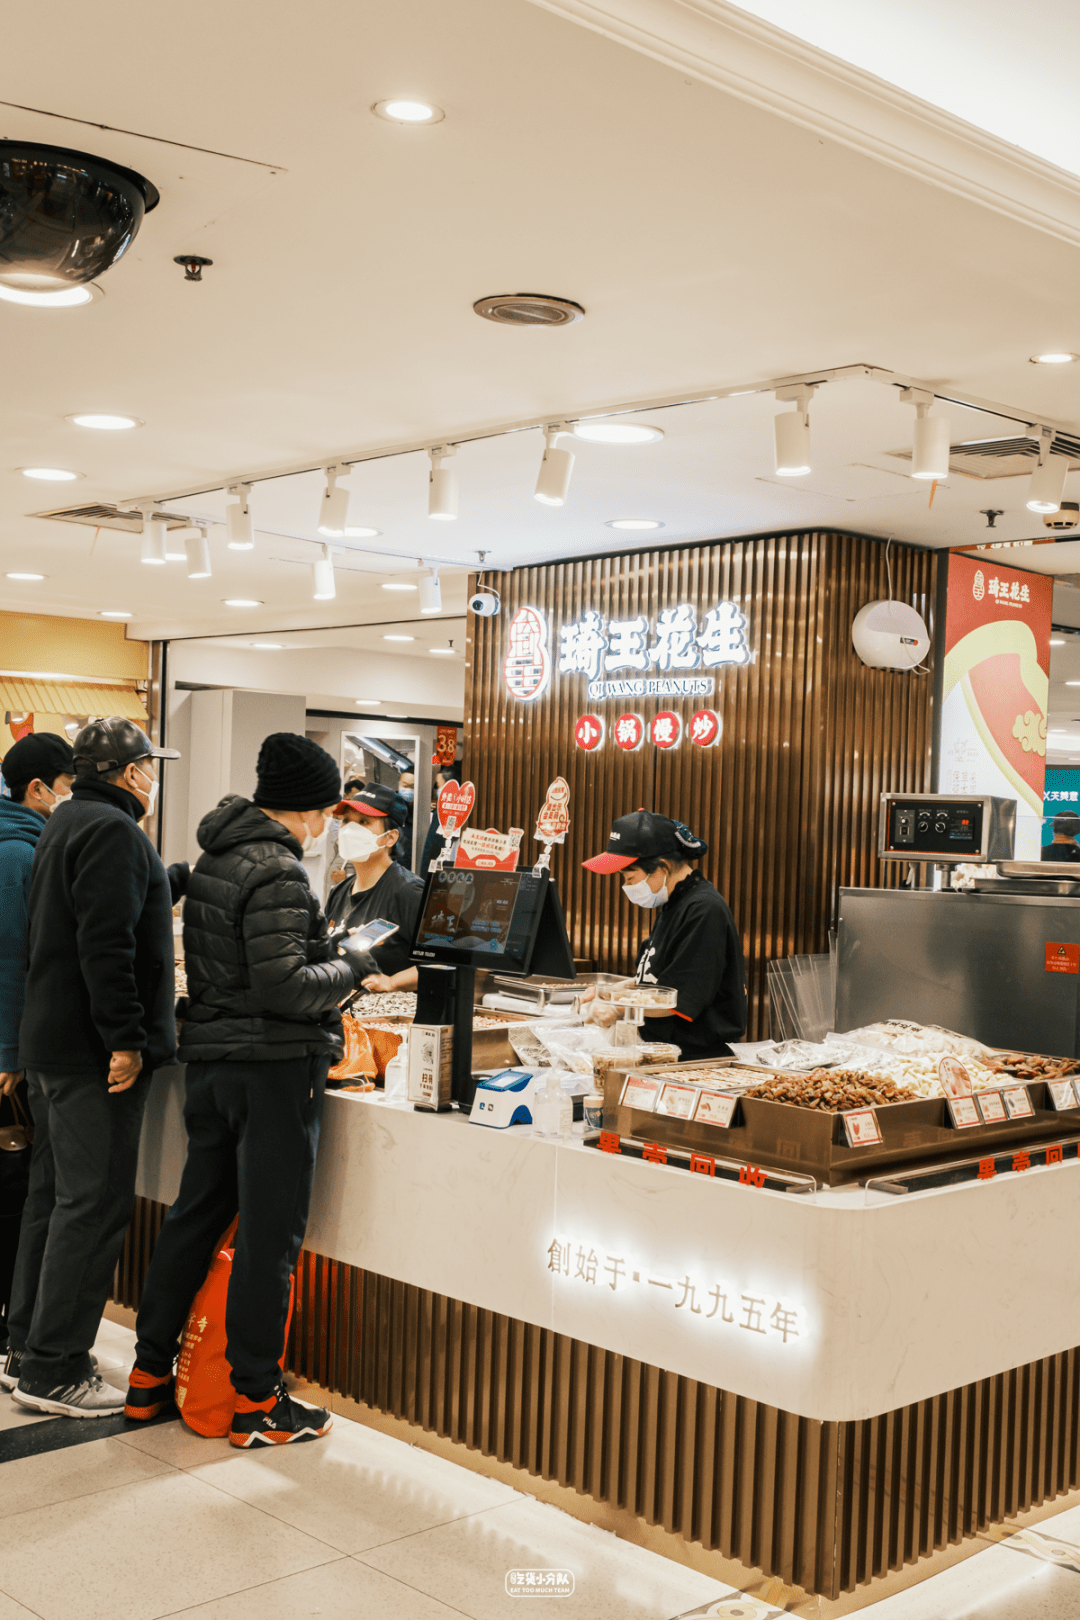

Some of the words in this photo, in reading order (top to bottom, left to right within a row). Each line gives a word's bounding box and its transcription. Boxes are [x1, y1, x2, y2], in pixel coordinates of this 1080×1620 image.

[988, 577, 1030, 603] 琦王花生
[558, 602, 750, 680] 琦王花生
[589, 681, 603, 697] QI
[607, 680, 642, 694] WANG
[648, 679, 708, 694] PEANUTS
[577, 713, 717, 747] 小锅慢炒
[976, 1143, 1080, 1180] 果壳回
[262, 1416, 277, 1429] FILA
